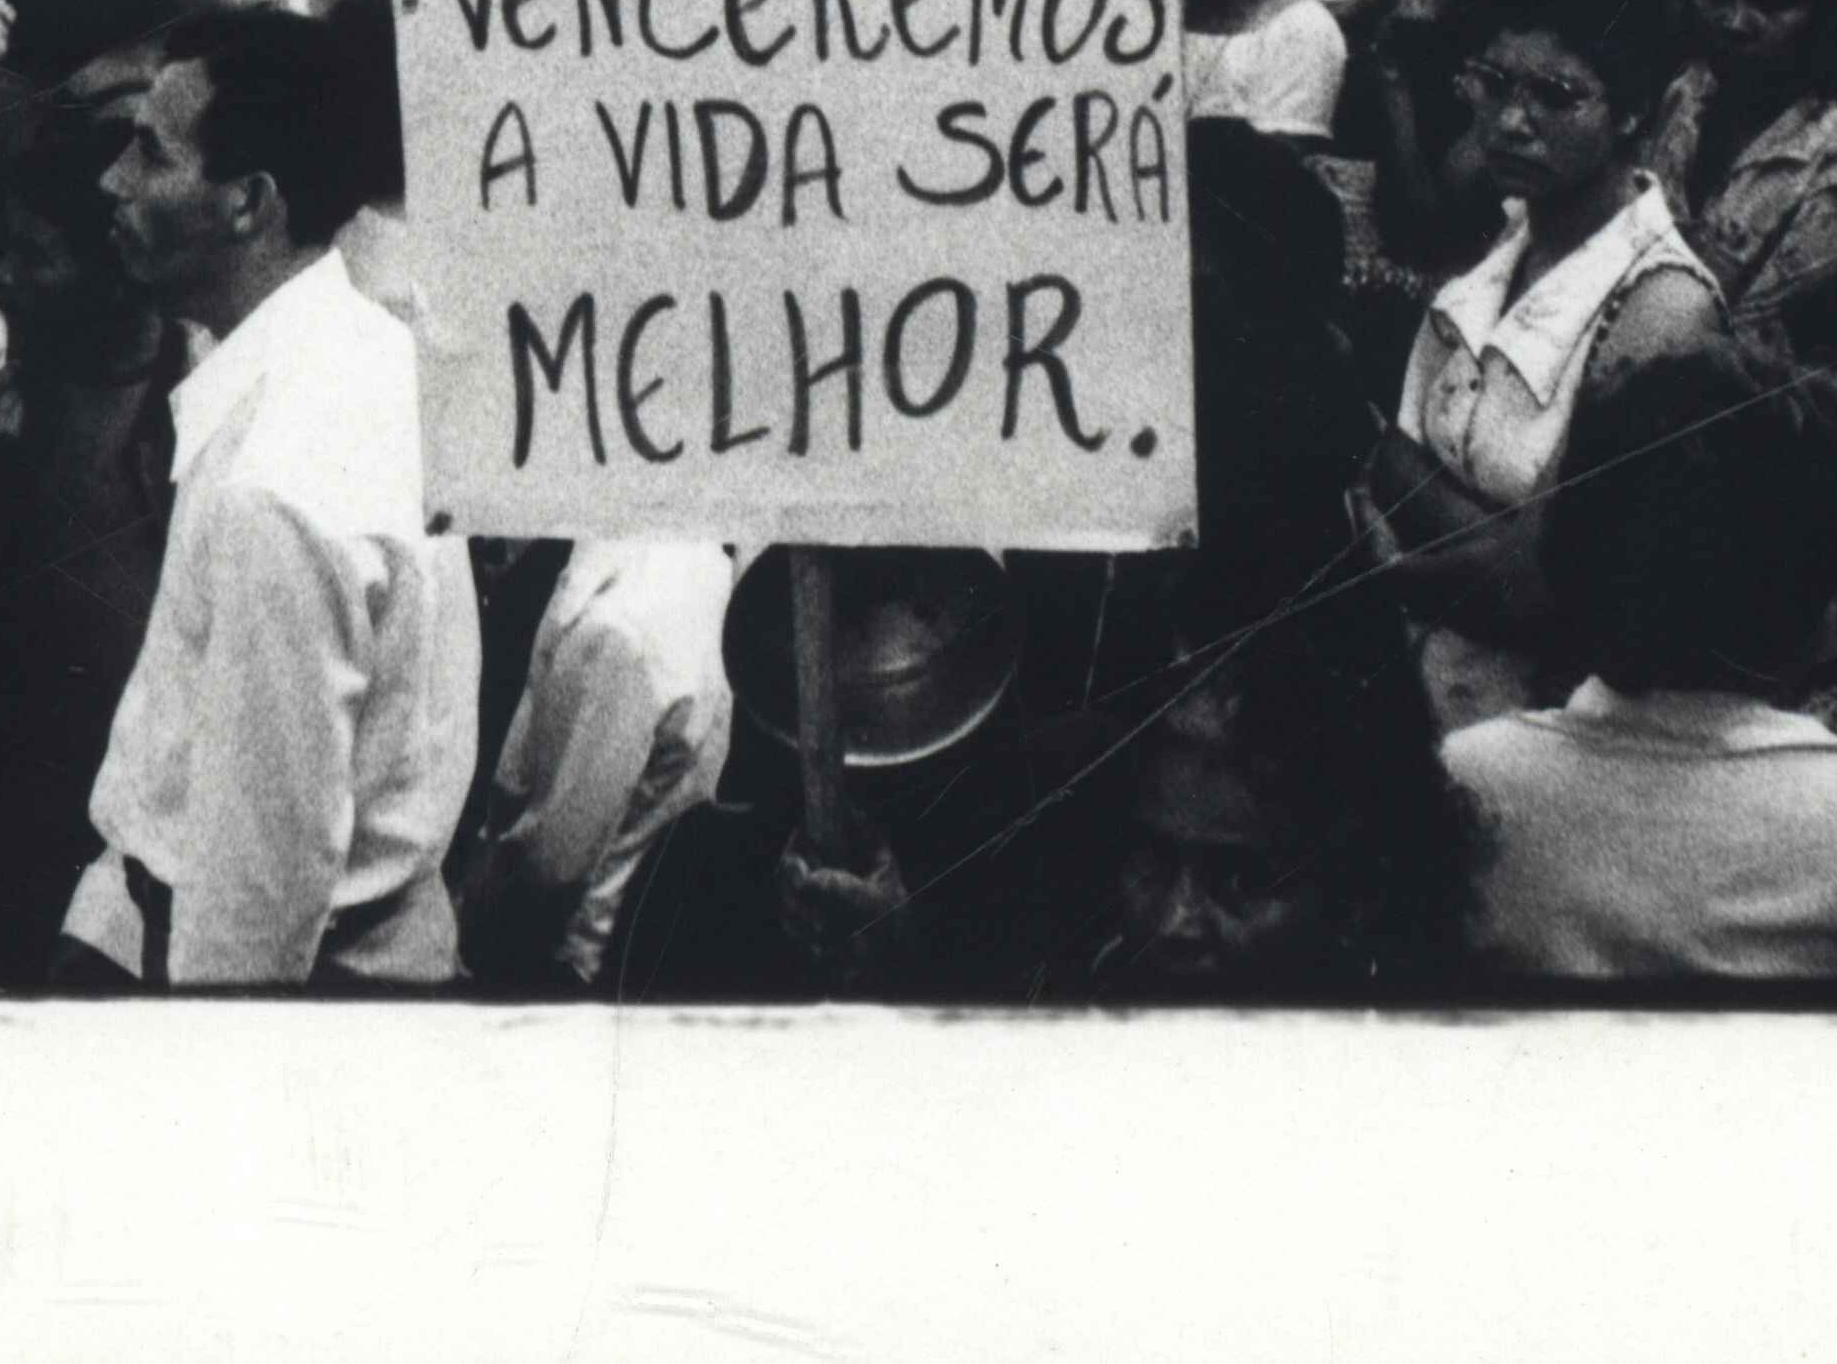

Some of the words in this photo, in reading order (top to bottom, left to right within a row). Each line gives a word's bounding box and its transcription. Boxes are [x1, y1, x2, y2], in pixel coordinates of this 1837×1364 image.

[479, 101, 537, 211] A
[595, 101, 847, 226] VIDA
[896, 74, 1176, 223] SERÁ
[507, 272, 1159, 469] MELHOR.
